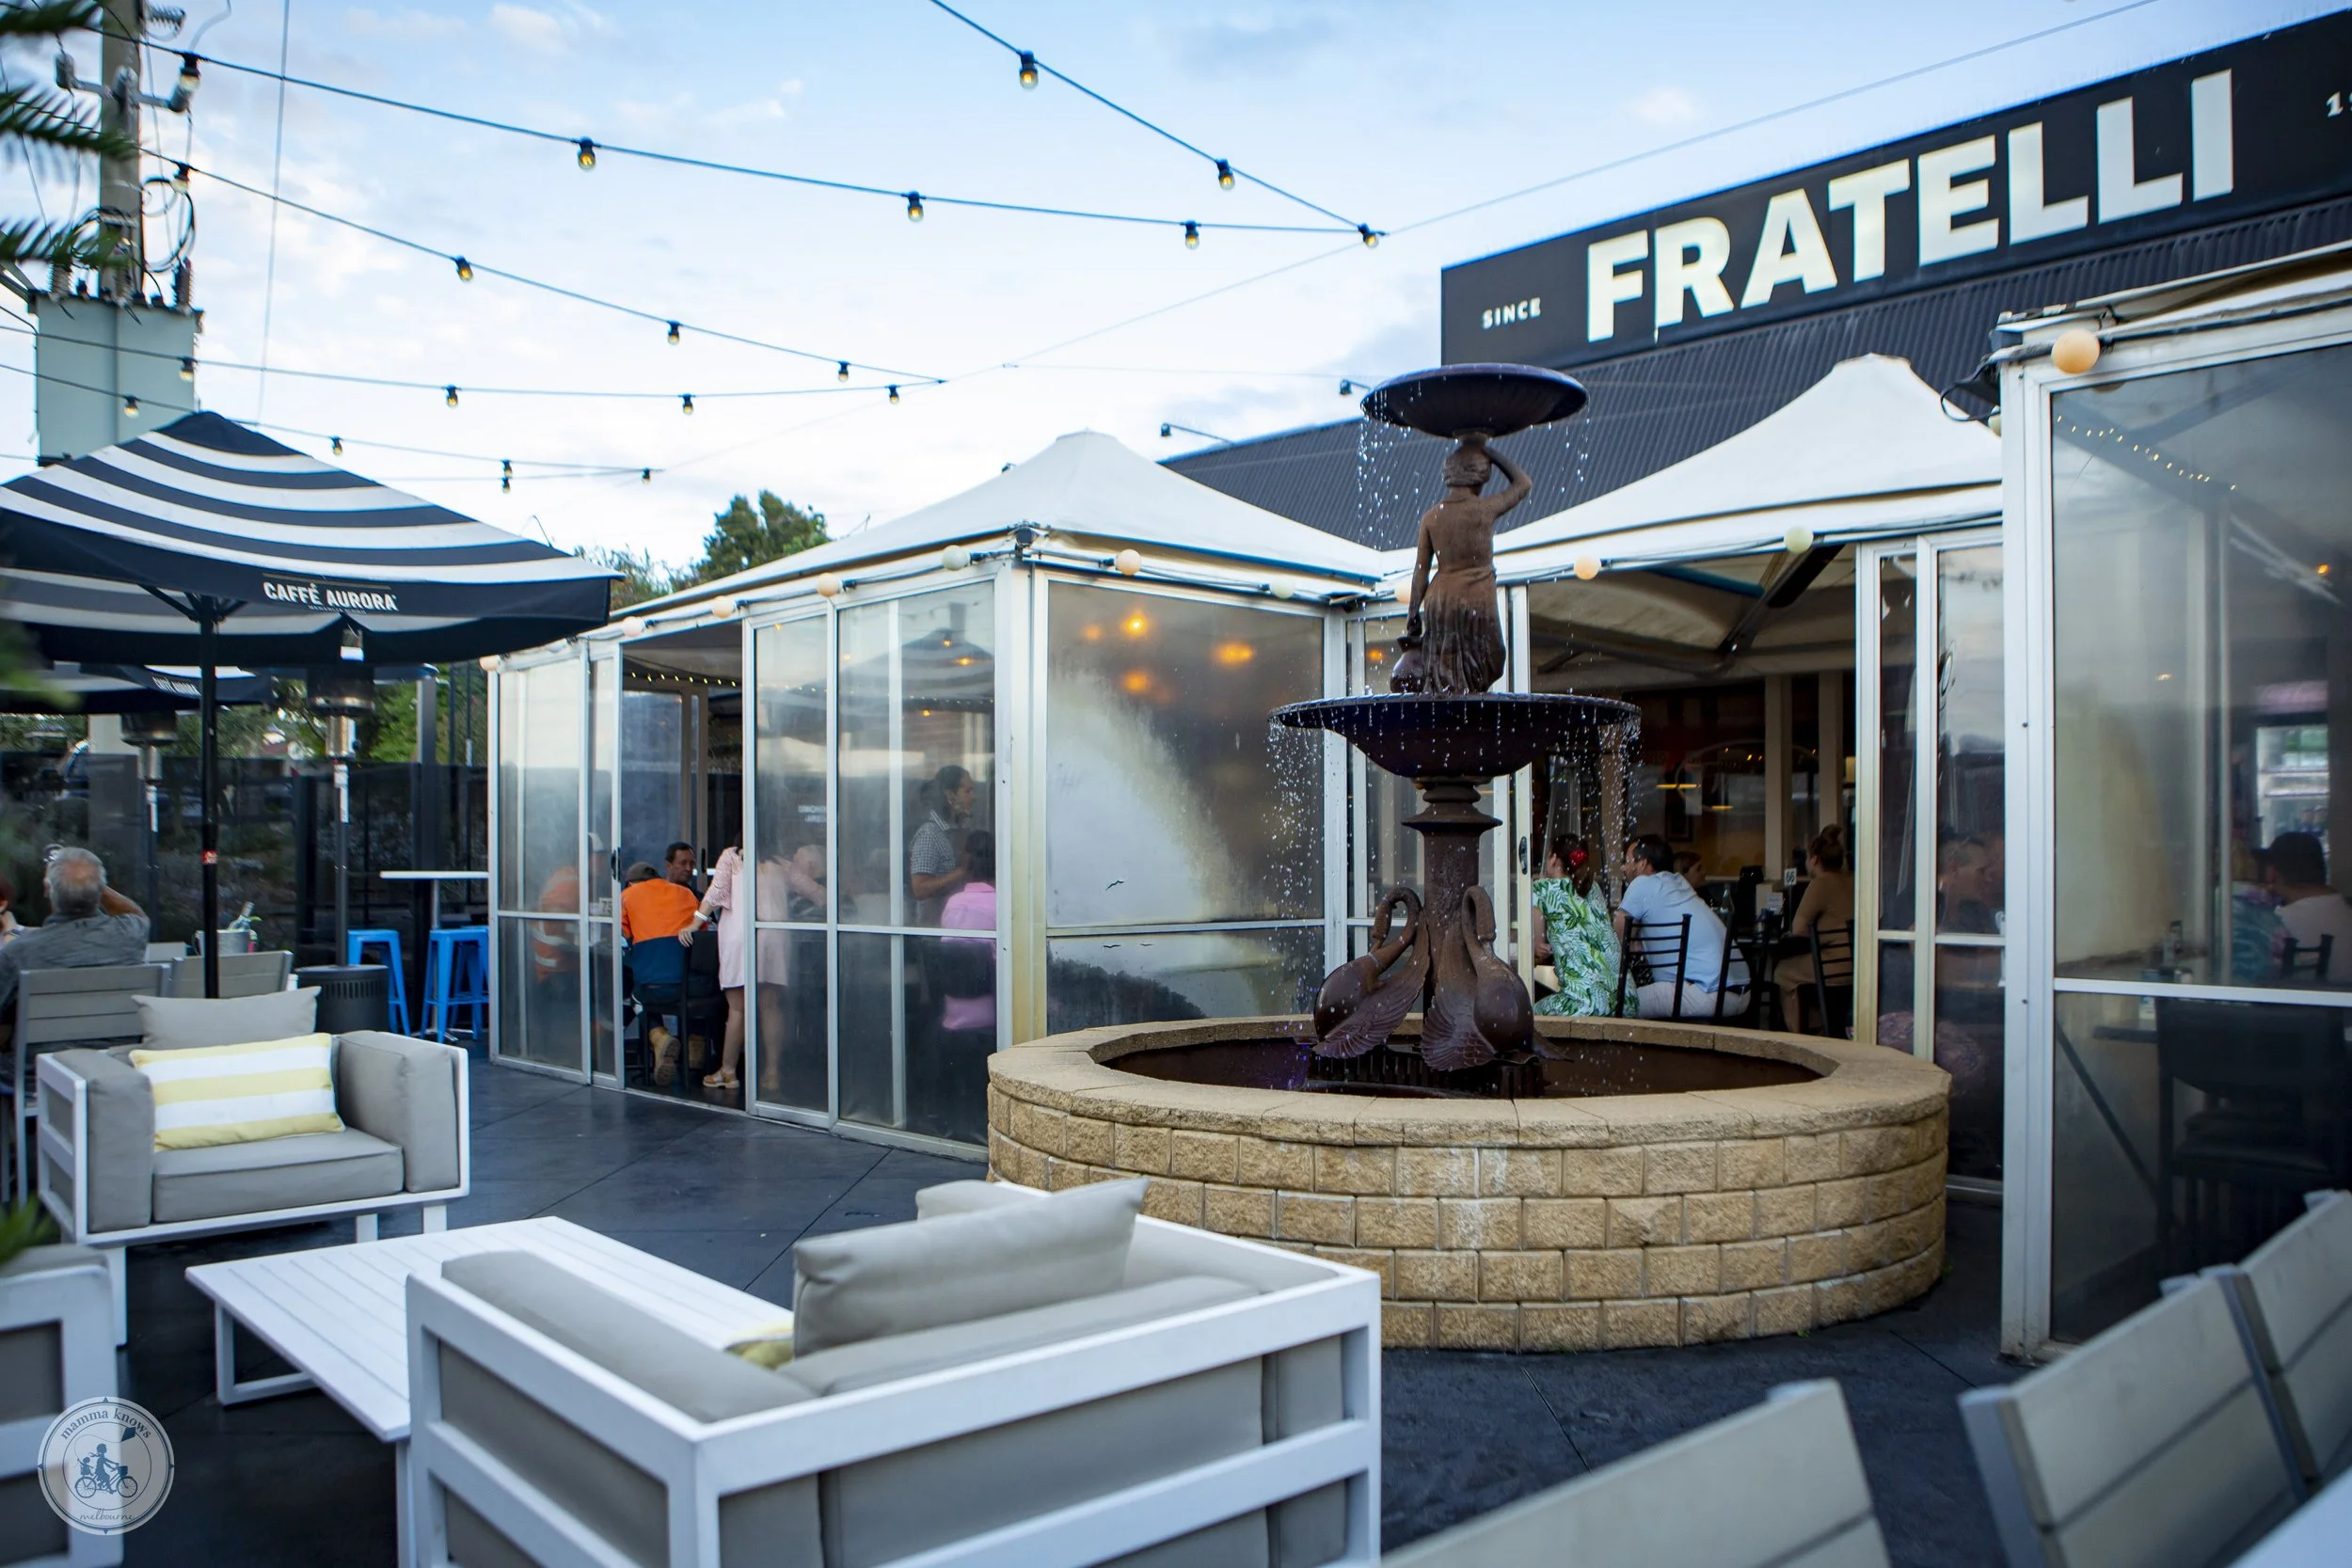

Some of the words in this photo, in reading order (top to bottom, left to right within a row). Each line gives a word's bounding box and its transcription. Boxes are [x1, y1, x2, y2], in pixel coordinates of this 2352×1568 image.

[2326, 90, 2352, 118] 1
[1587, 69, 2233, 343] FRATELLI
[1482, 296, 1541, 329] SINCE
[326, 589, 399, 611] AURORA
